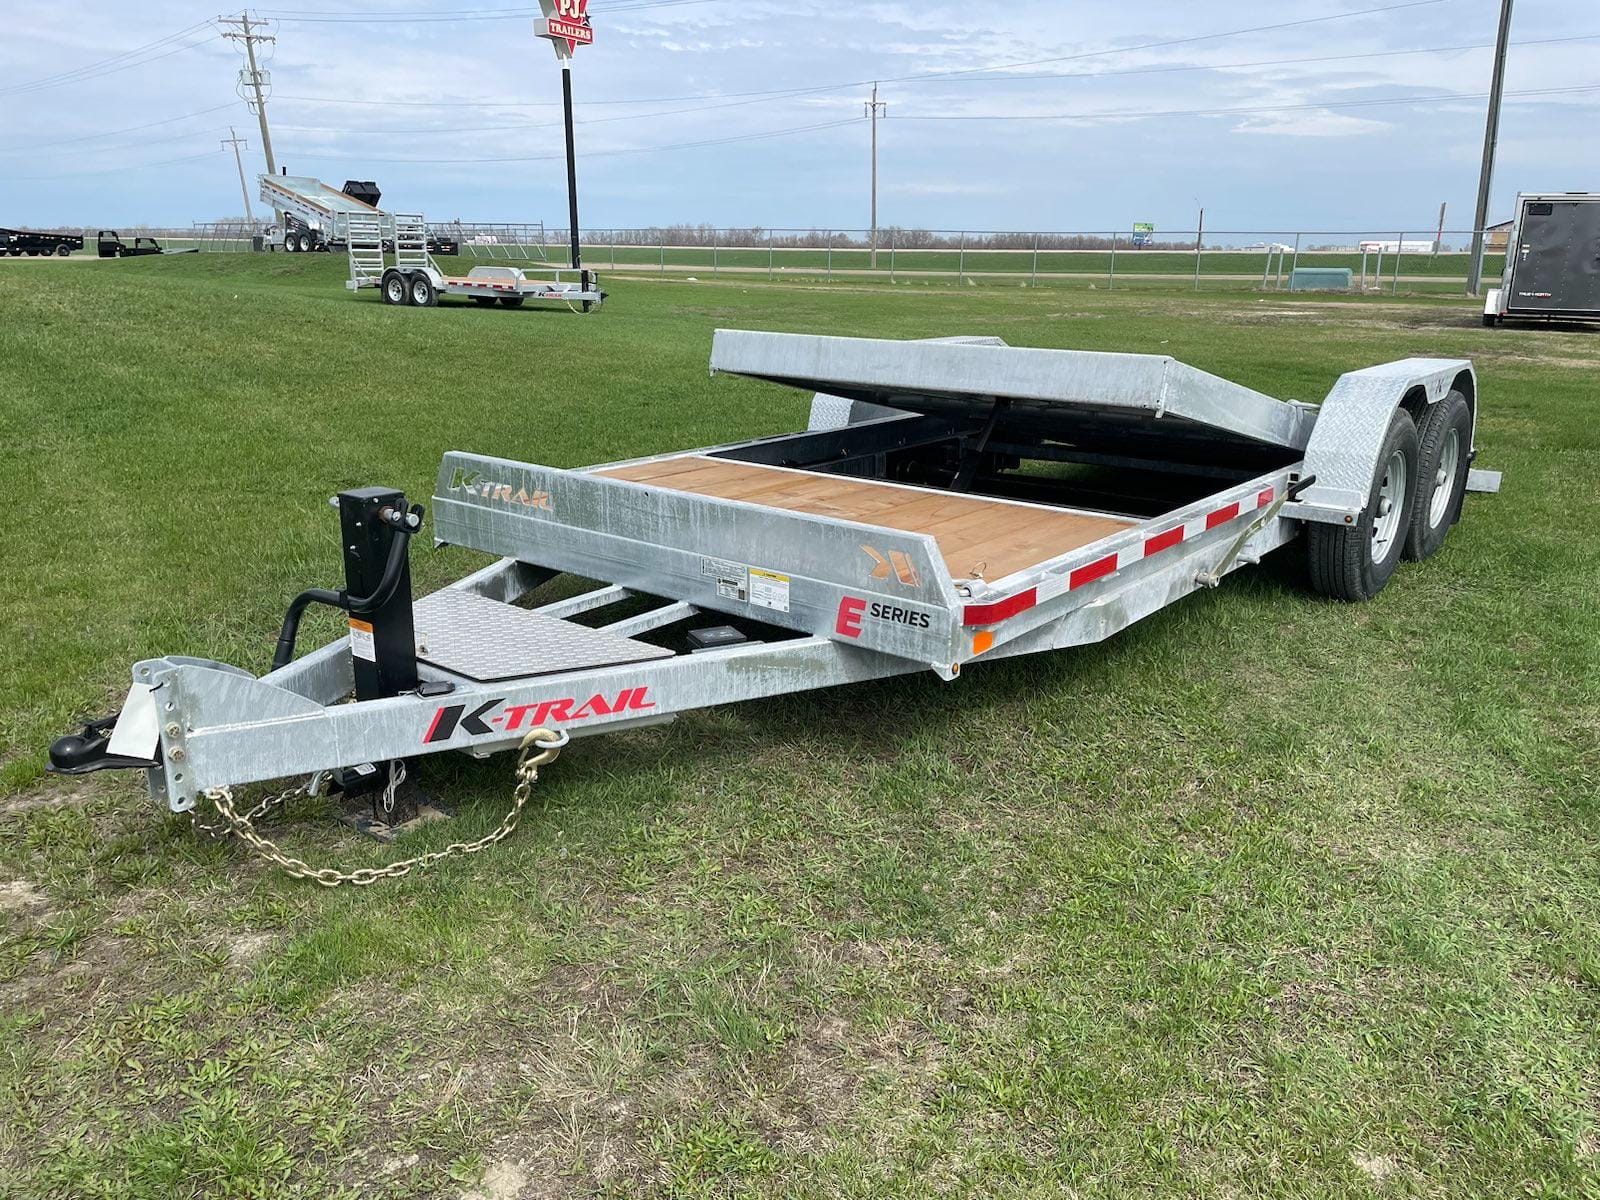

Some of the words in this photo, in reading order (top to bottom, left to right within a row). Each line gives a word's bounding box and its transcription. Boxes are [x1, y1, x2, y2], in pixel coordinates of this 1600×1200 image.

[550, 22, 591, 40] TRAILERS
[447, 466, 555, 512] K-TRAIL
[835, 595, 867, 639] E
[870, 602, 931, 629] SERIES
[423, 686, 656, 744] K-TRAIL
